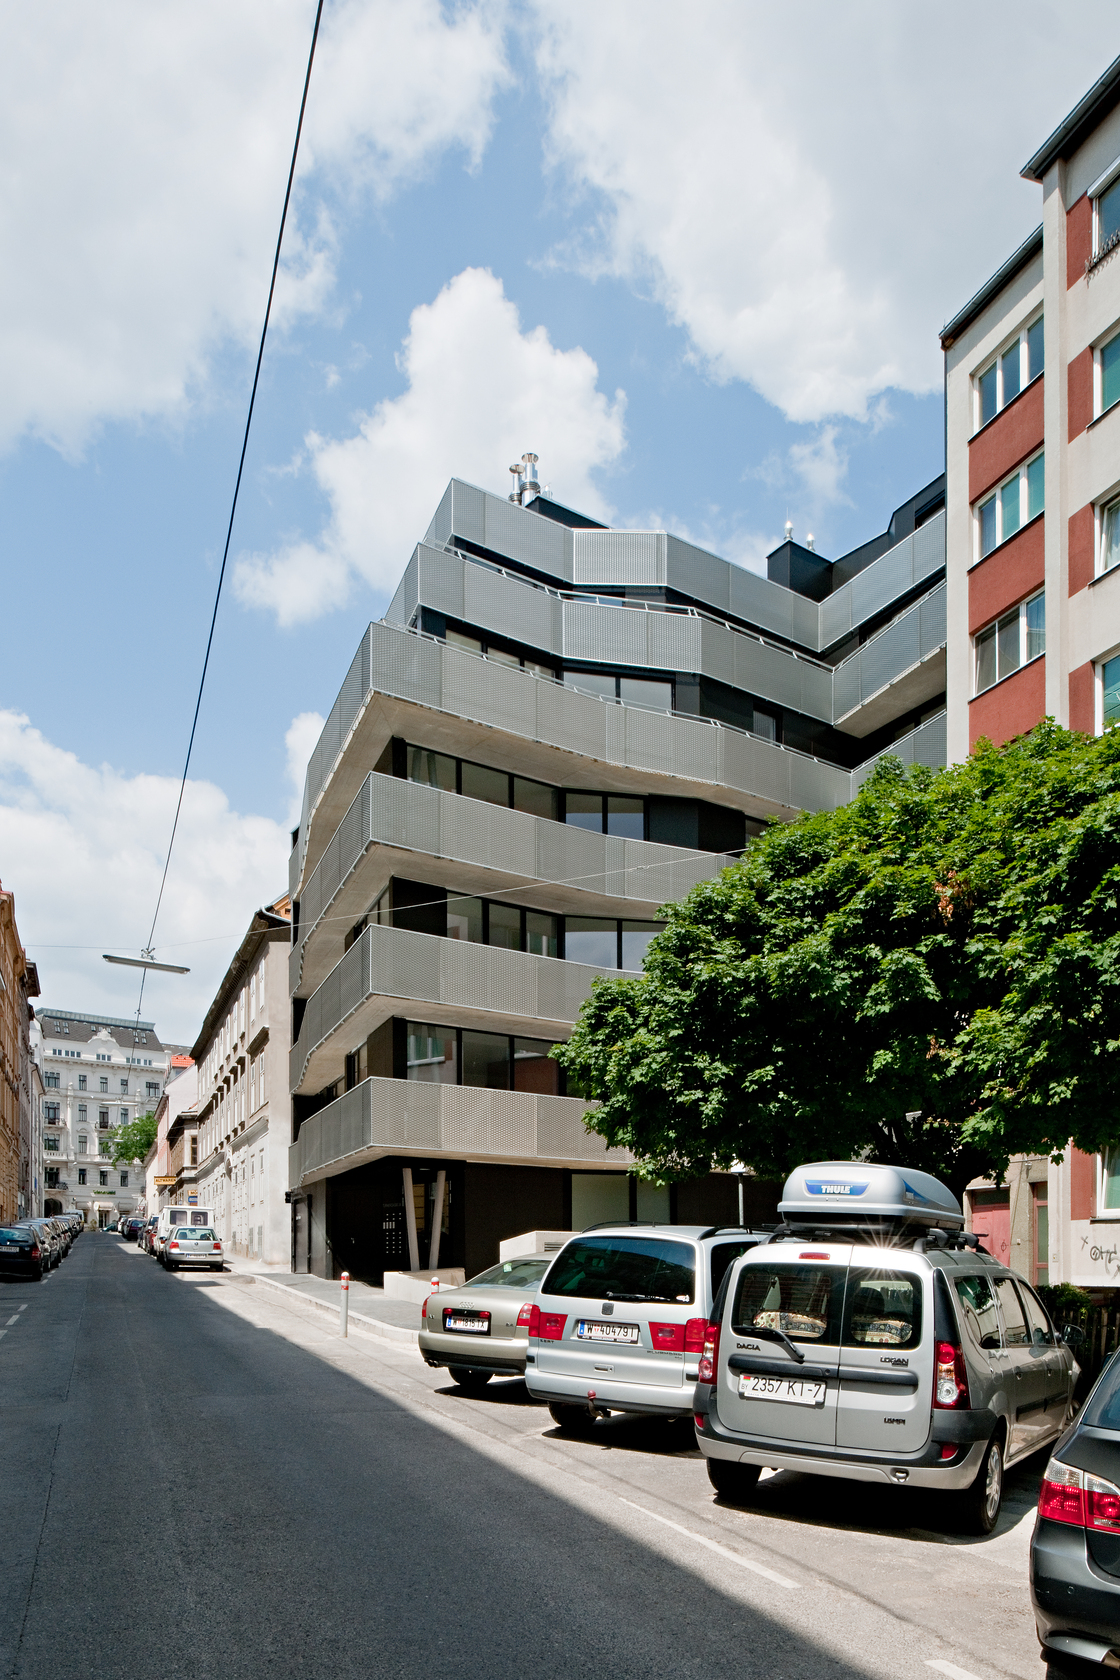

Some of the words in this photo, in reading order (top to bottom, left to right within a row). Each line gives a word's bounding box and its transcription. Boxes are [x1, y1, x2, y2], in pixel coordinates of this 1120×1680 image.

[821, 1185, 850, 1194] THULE
[736, 1342, 761, 1351] DACIA
[880, 1356, 909, 1366] LOGAN
[752, 1376, 783, 1393] 2357
